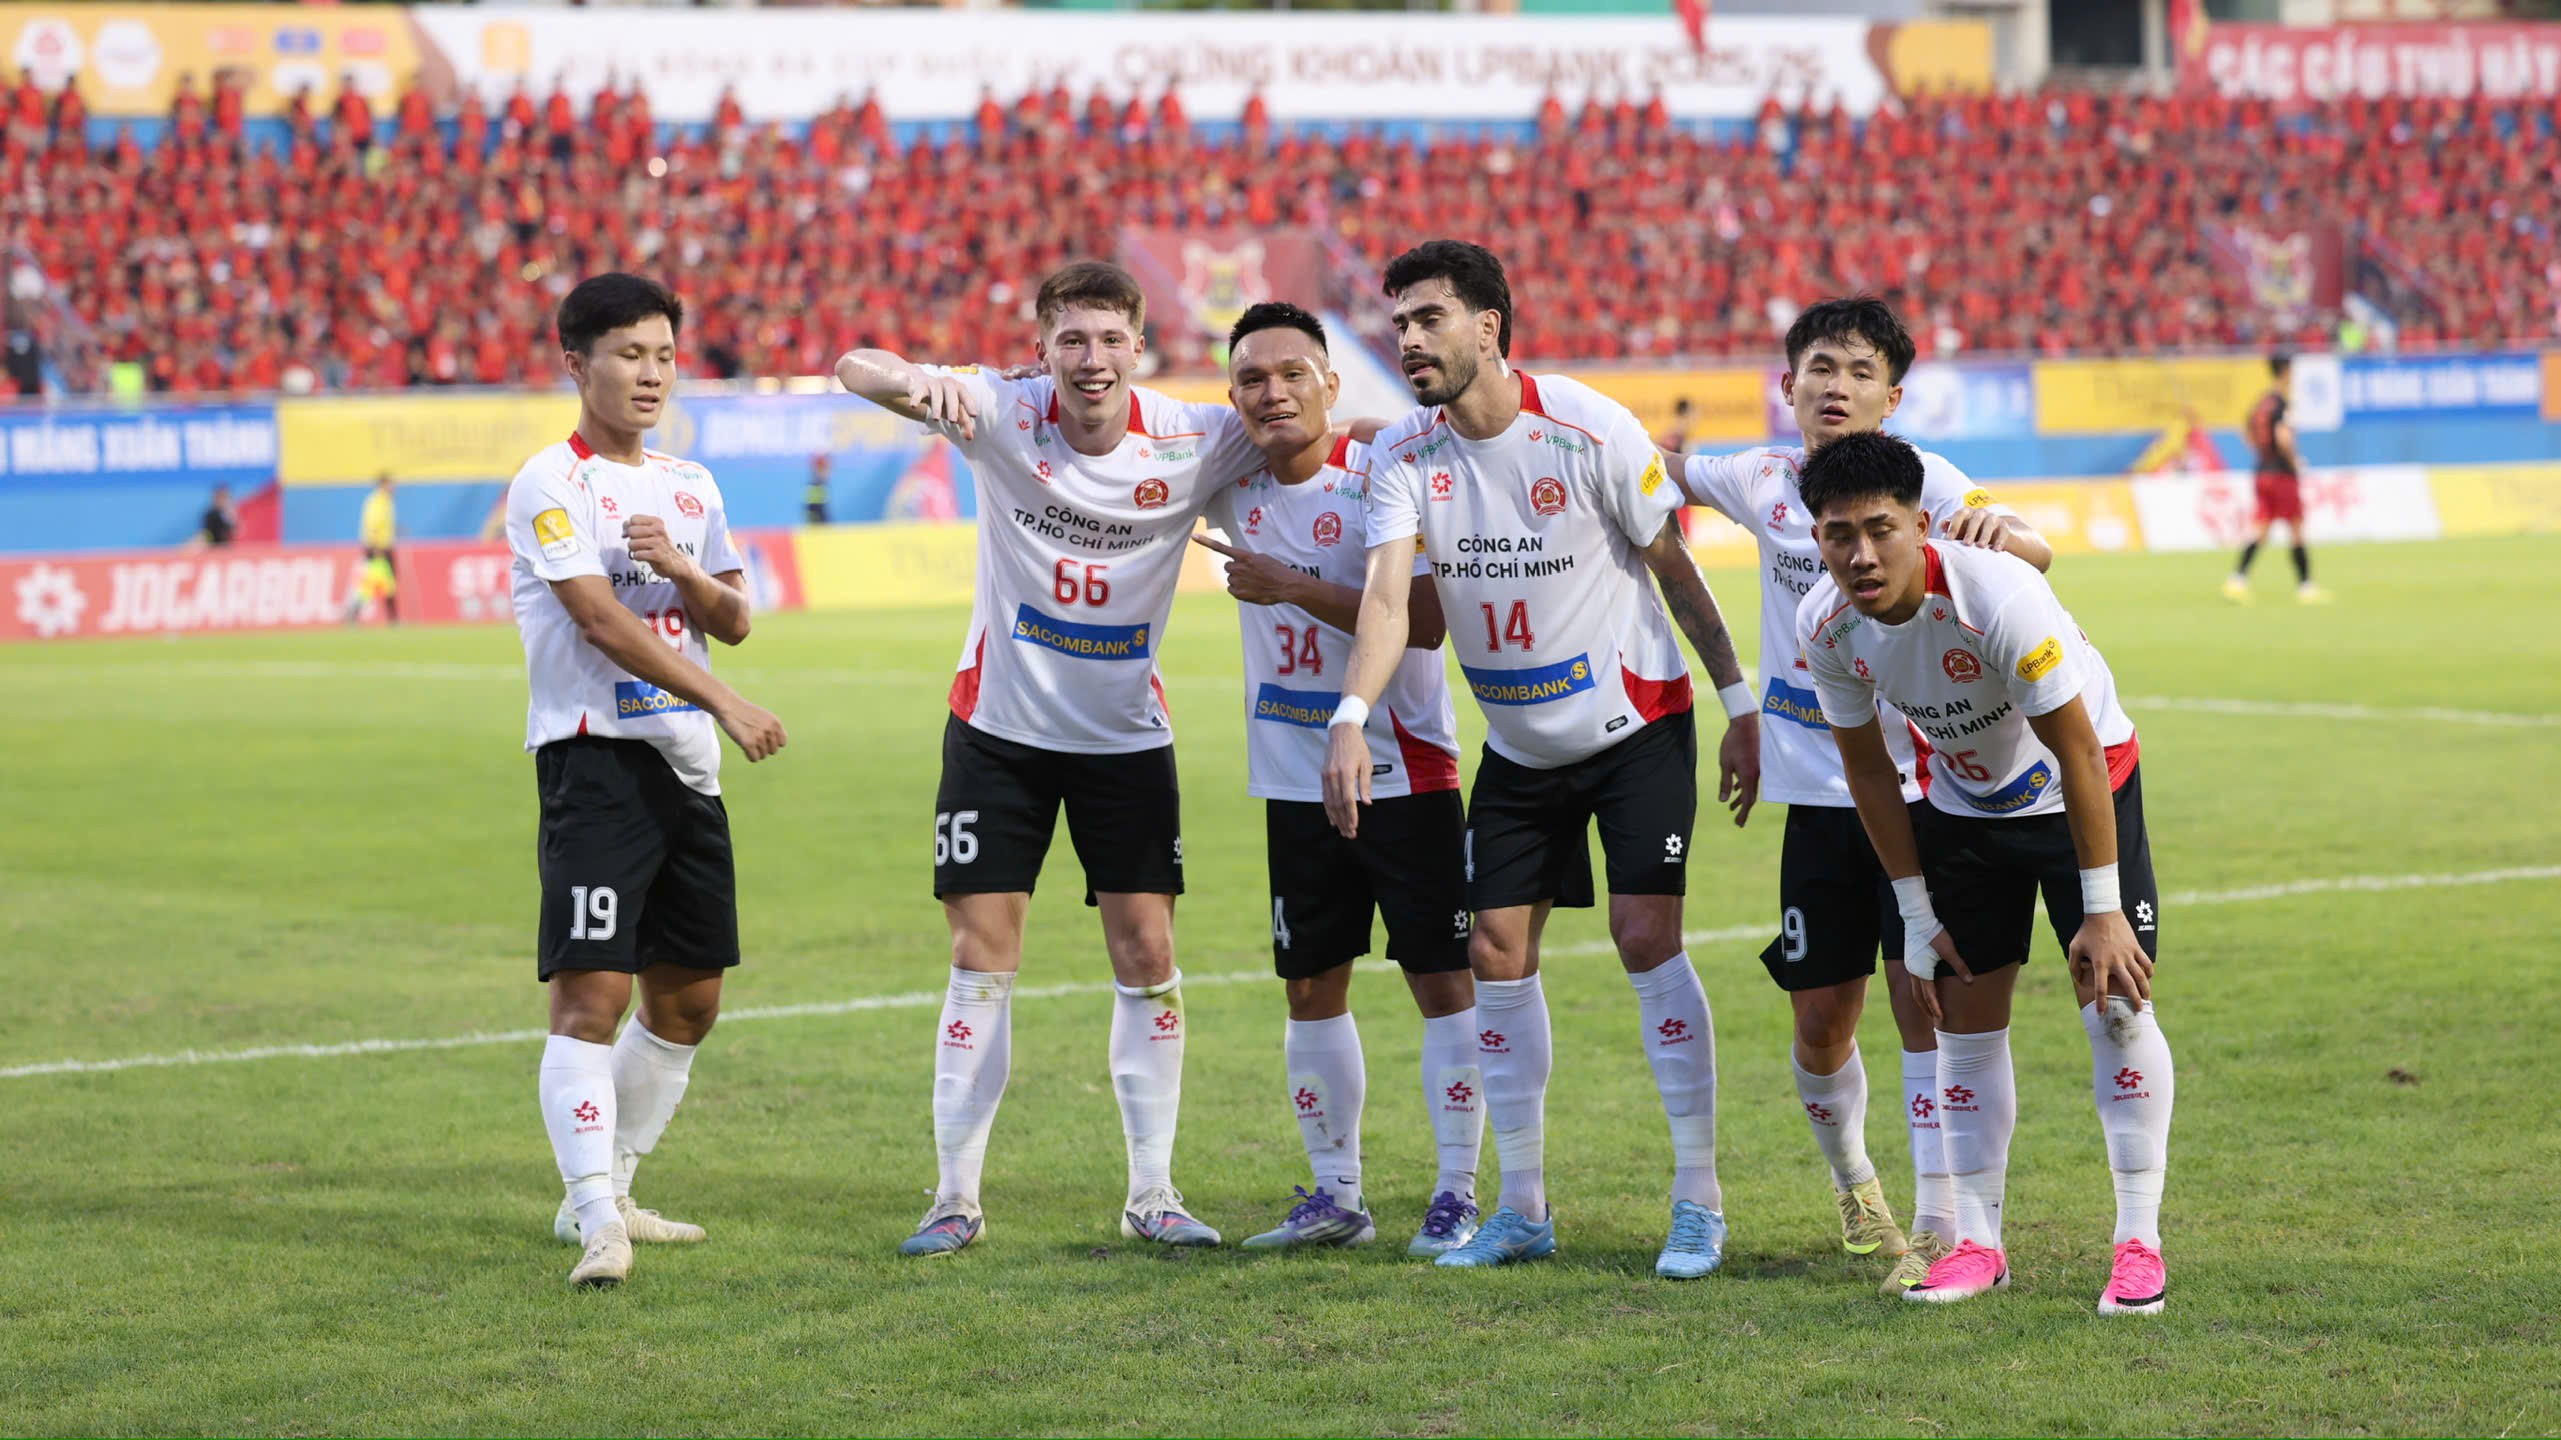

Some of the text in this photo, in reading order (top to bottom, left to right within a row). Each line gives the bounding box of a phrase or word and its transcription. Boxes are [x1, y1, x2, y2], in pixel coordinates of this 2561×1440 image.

[1416, 434, 1450, 460] VPBank
[1545, 433, 1585, 456] VPBank
[1045, 505, 1133, 536] CÔNG AN
[1069, 534, 1102, 550] CHÍ
[1107, 534, 1154, 551] MINH
[1457, 534, 1543, 553] CÔNG AN
[1432, 555, 1575, 579] TP.HỒ CHÍ MINH
[1777, 551, 1814, 574] CÔNG
[1054, 558, 1111, 608] 66
[1016, 621, 1131, 655] SACOMBANK
[1480, 599, 1536, 653] 14
[1275, 623, 1323, 677] 34
[2021, 649, 2054, 674] LPBank
[1257, 700, 1337, 724] SACOMBAN
[1926, 701, 2013, 740] CHÍ MINH
[1946, 698, 1973, 717] AN
[934, 810, 979, 866] 66
[570, 885, 619, 941] 19
